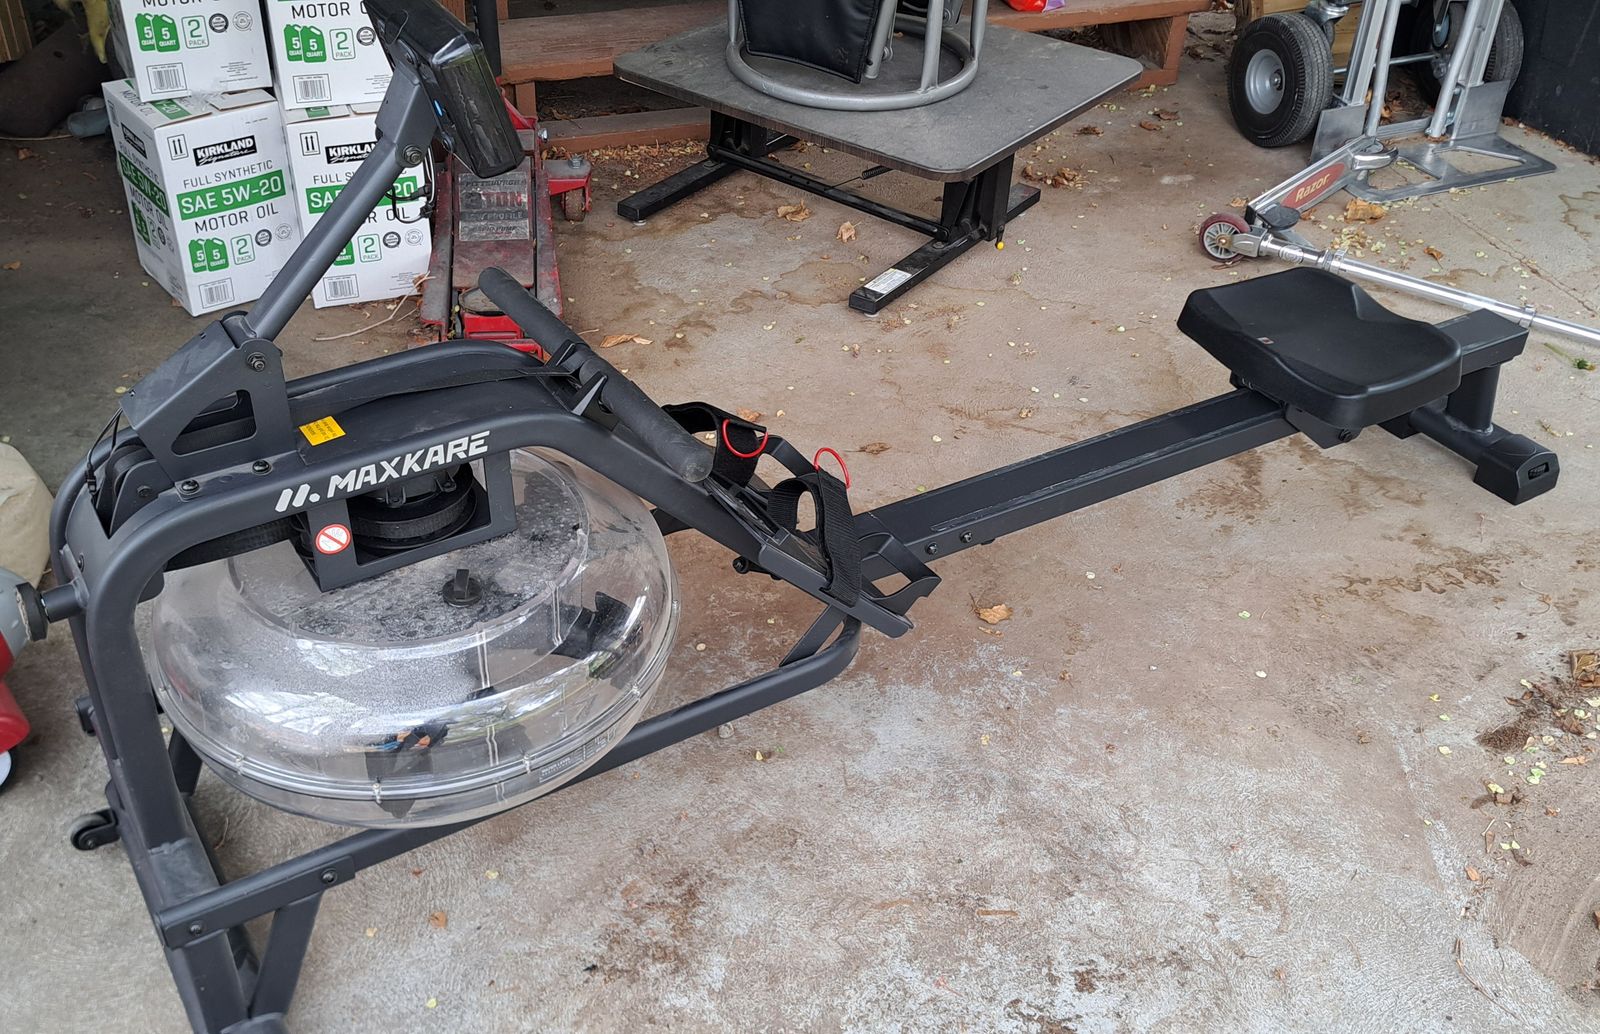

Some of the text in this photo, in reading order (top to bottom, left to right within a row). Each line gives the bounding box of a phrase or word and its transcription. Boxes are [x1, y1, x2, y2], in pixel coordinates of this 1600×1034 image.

[291, 1, 351, 19] MOTOR
[144, 26, 170, 39] 5 5
[188, 19, 202, 39] 2
[292, 37, 318, 51] 5 5
[335, 31, 349, 50] 2
[196, 138, 254, 159] KIRKLAND
[198, 149, 256, 166] Signature
[328, 142, 377, 158] KIRKLA
[183, 159, 273, 189] FULL SYNTHETIC
[313, 172, 343, 185] FULL
[181, 176, 282, 214] SAE 5W-20
[1295, 173, 1331, 203] Razor
[195, 202, 279, 234] MOTOR OIL
[236, 238, 249, 255] 2
[363, 237, 376, 253] 2
[196, 249, 220, 261] 5 5
[327, 430, 491, 498] MAXKARE
